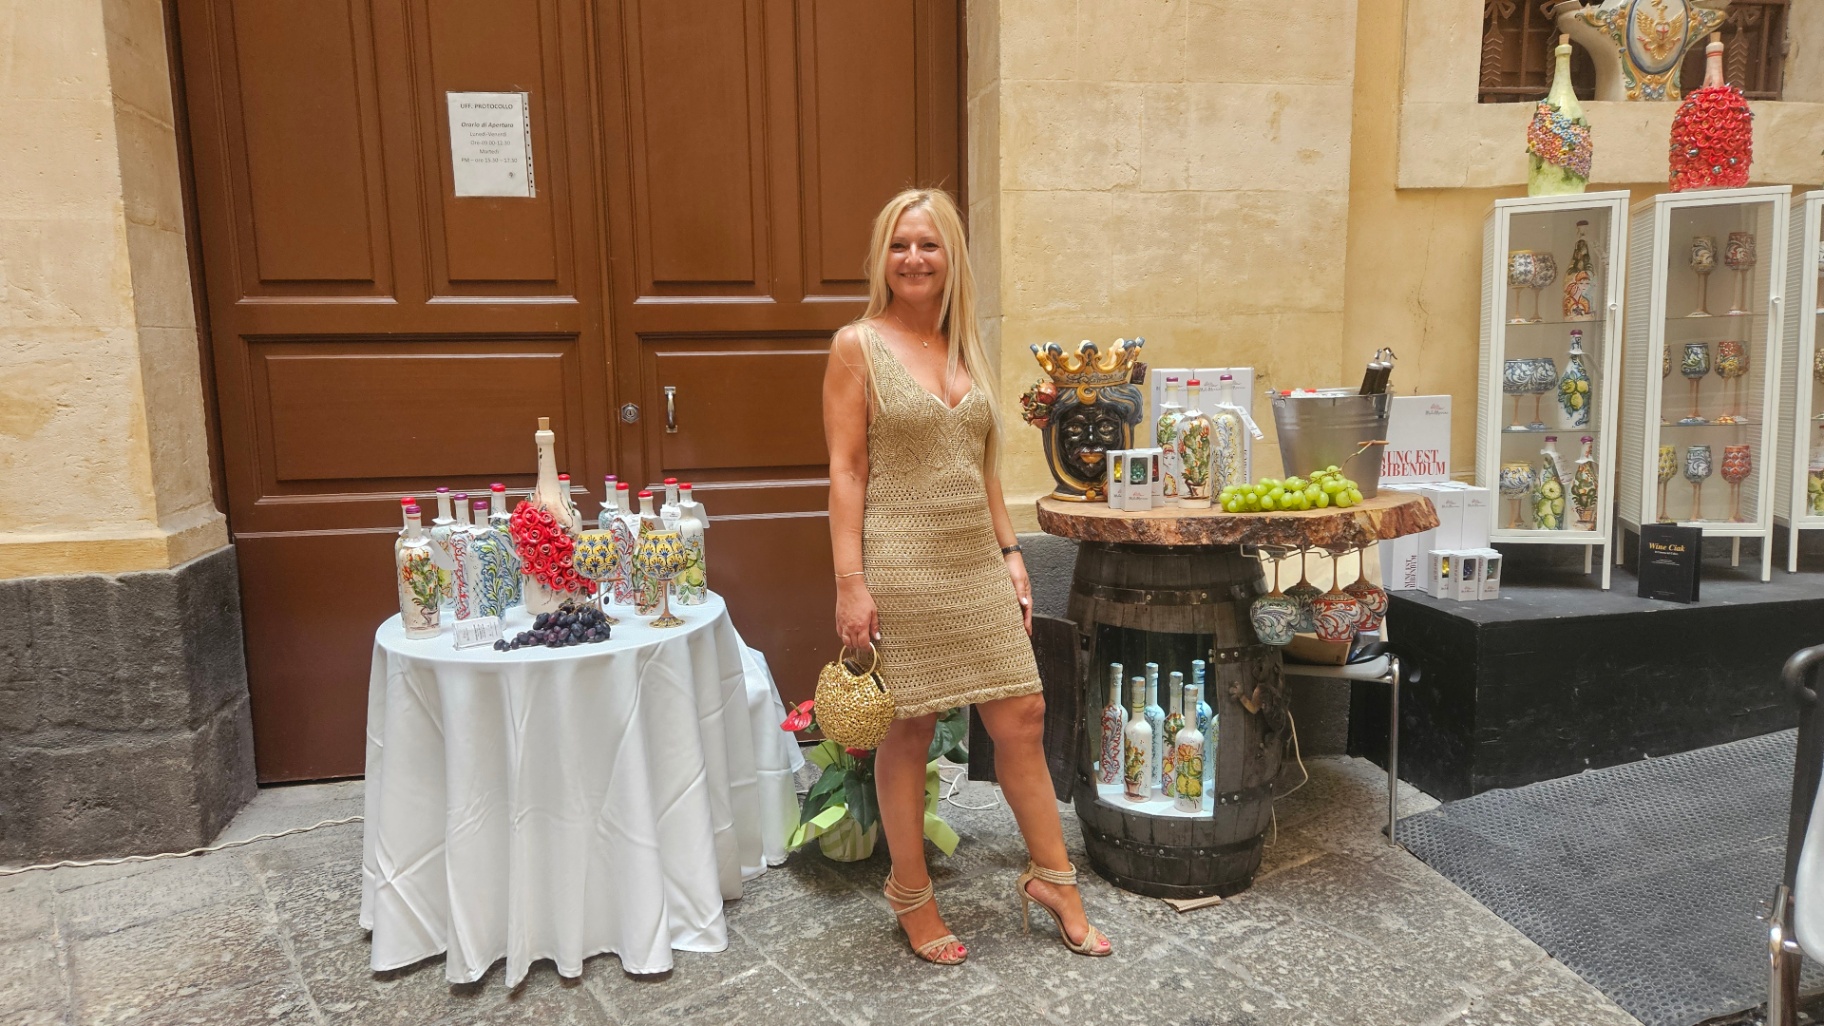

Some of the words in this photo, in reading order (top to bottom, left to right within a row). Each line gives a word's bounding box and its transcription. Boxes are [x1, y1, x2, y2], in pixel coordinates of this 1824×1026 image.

[488, 121, 514, 129] Apertura
[1415, 449, 1439, 464] EST
[1380, 461, 1446, 477] BIBENDUM
[1649, 542, 1667, 551] Wine
[1668, 543, 1686, 552] Ciak
